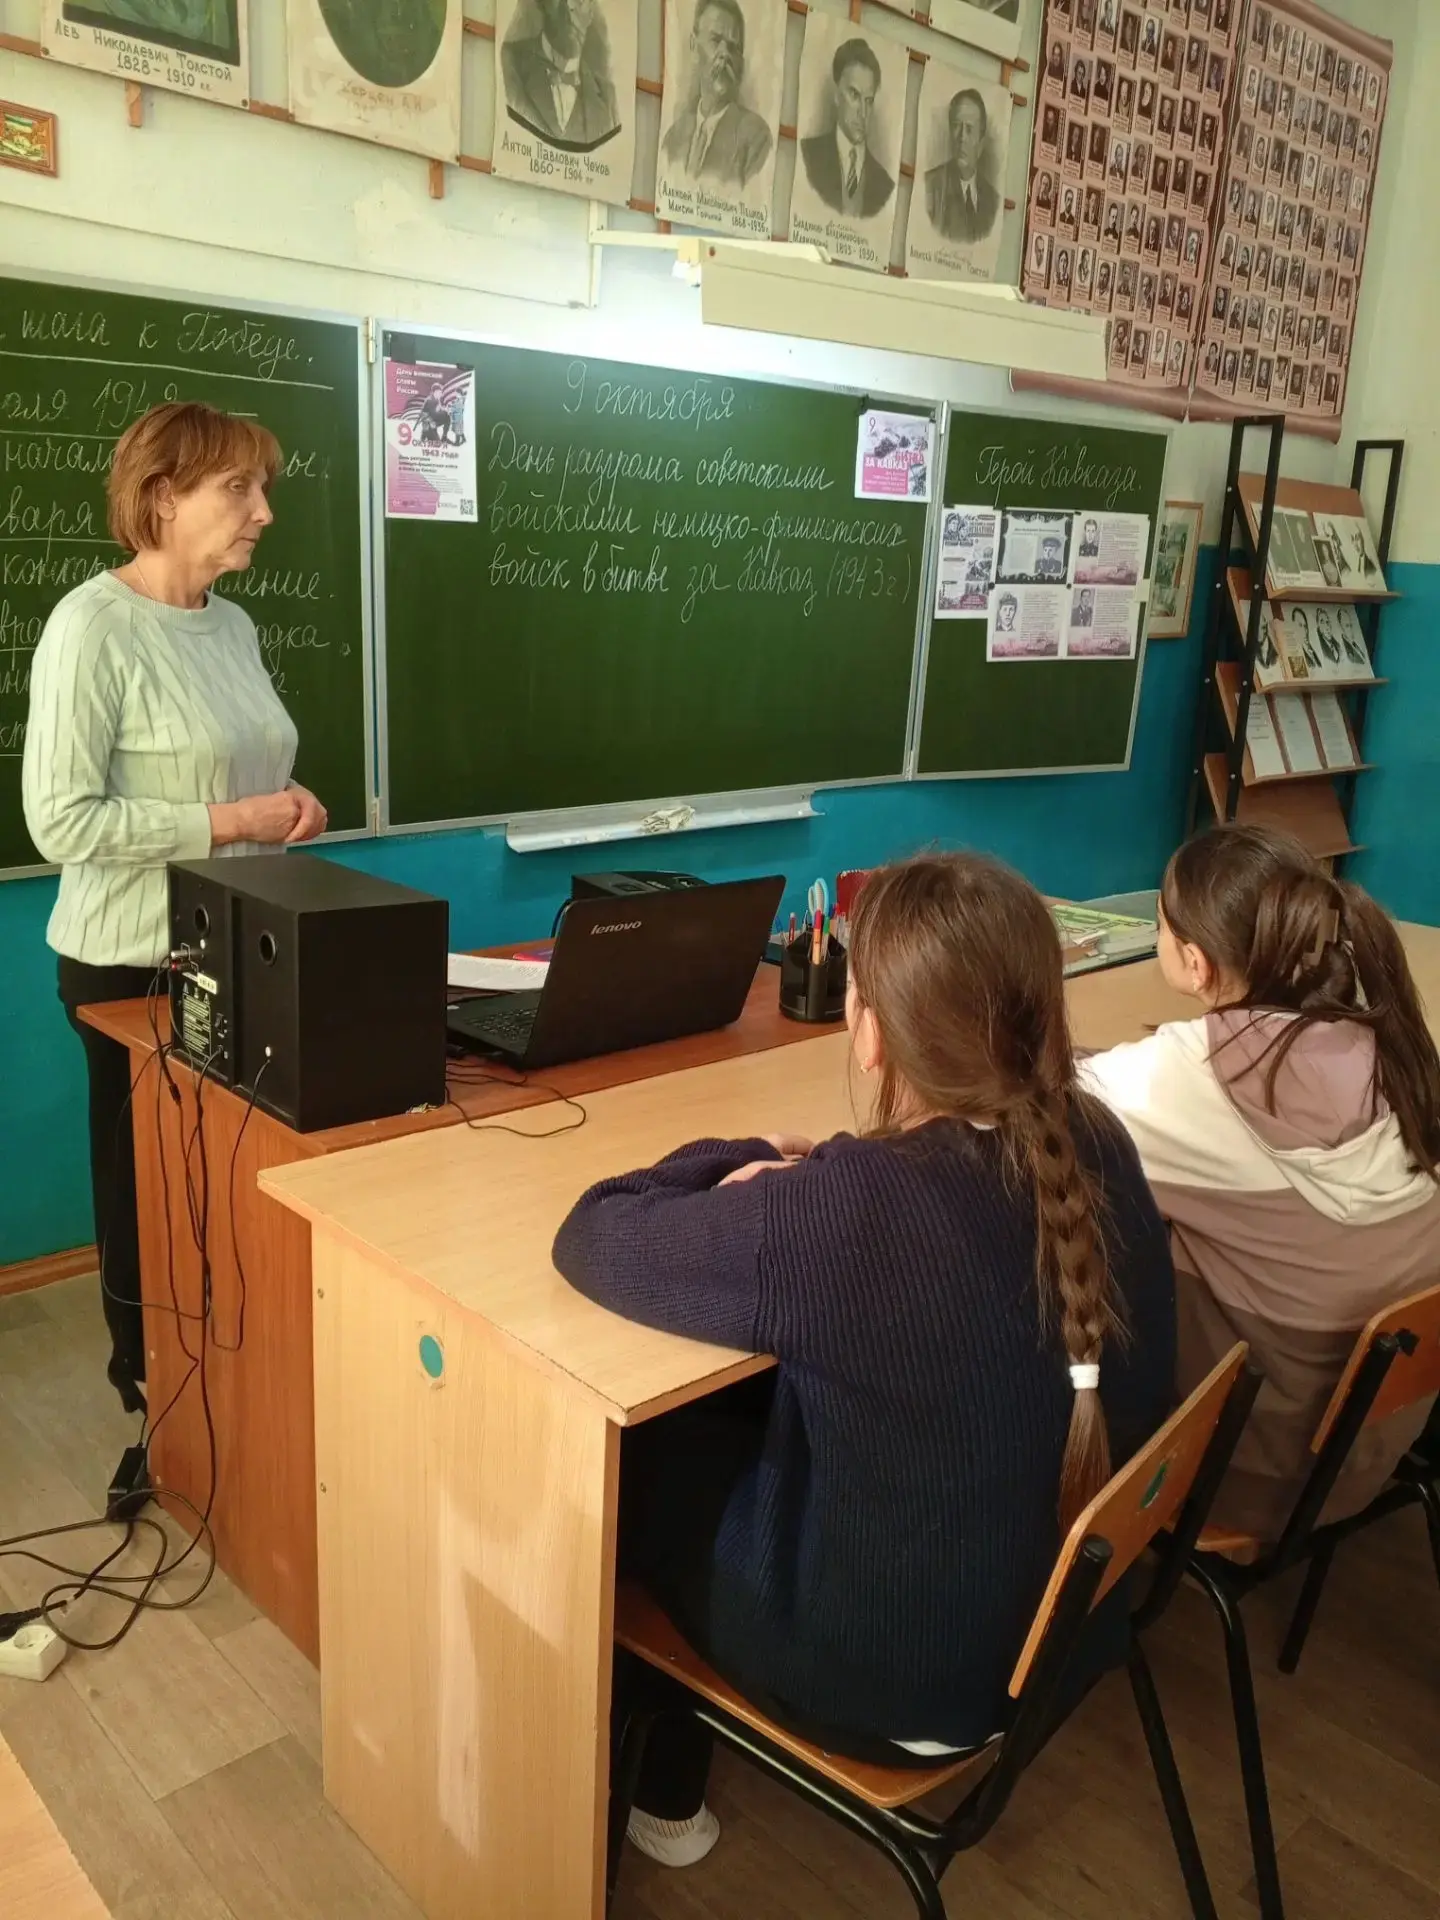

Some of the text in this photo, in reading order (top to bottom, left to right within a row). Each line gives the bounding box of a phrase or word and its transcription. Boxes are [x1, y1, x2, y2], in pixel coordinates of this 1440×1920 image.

[563, 360, 736, 431] 9 октября
[397, 423, 412, 446] 9
[488, 420, 555, 475] День
[557, 444, 684, 514] разгрома
[681, 562, 731, 624] за
